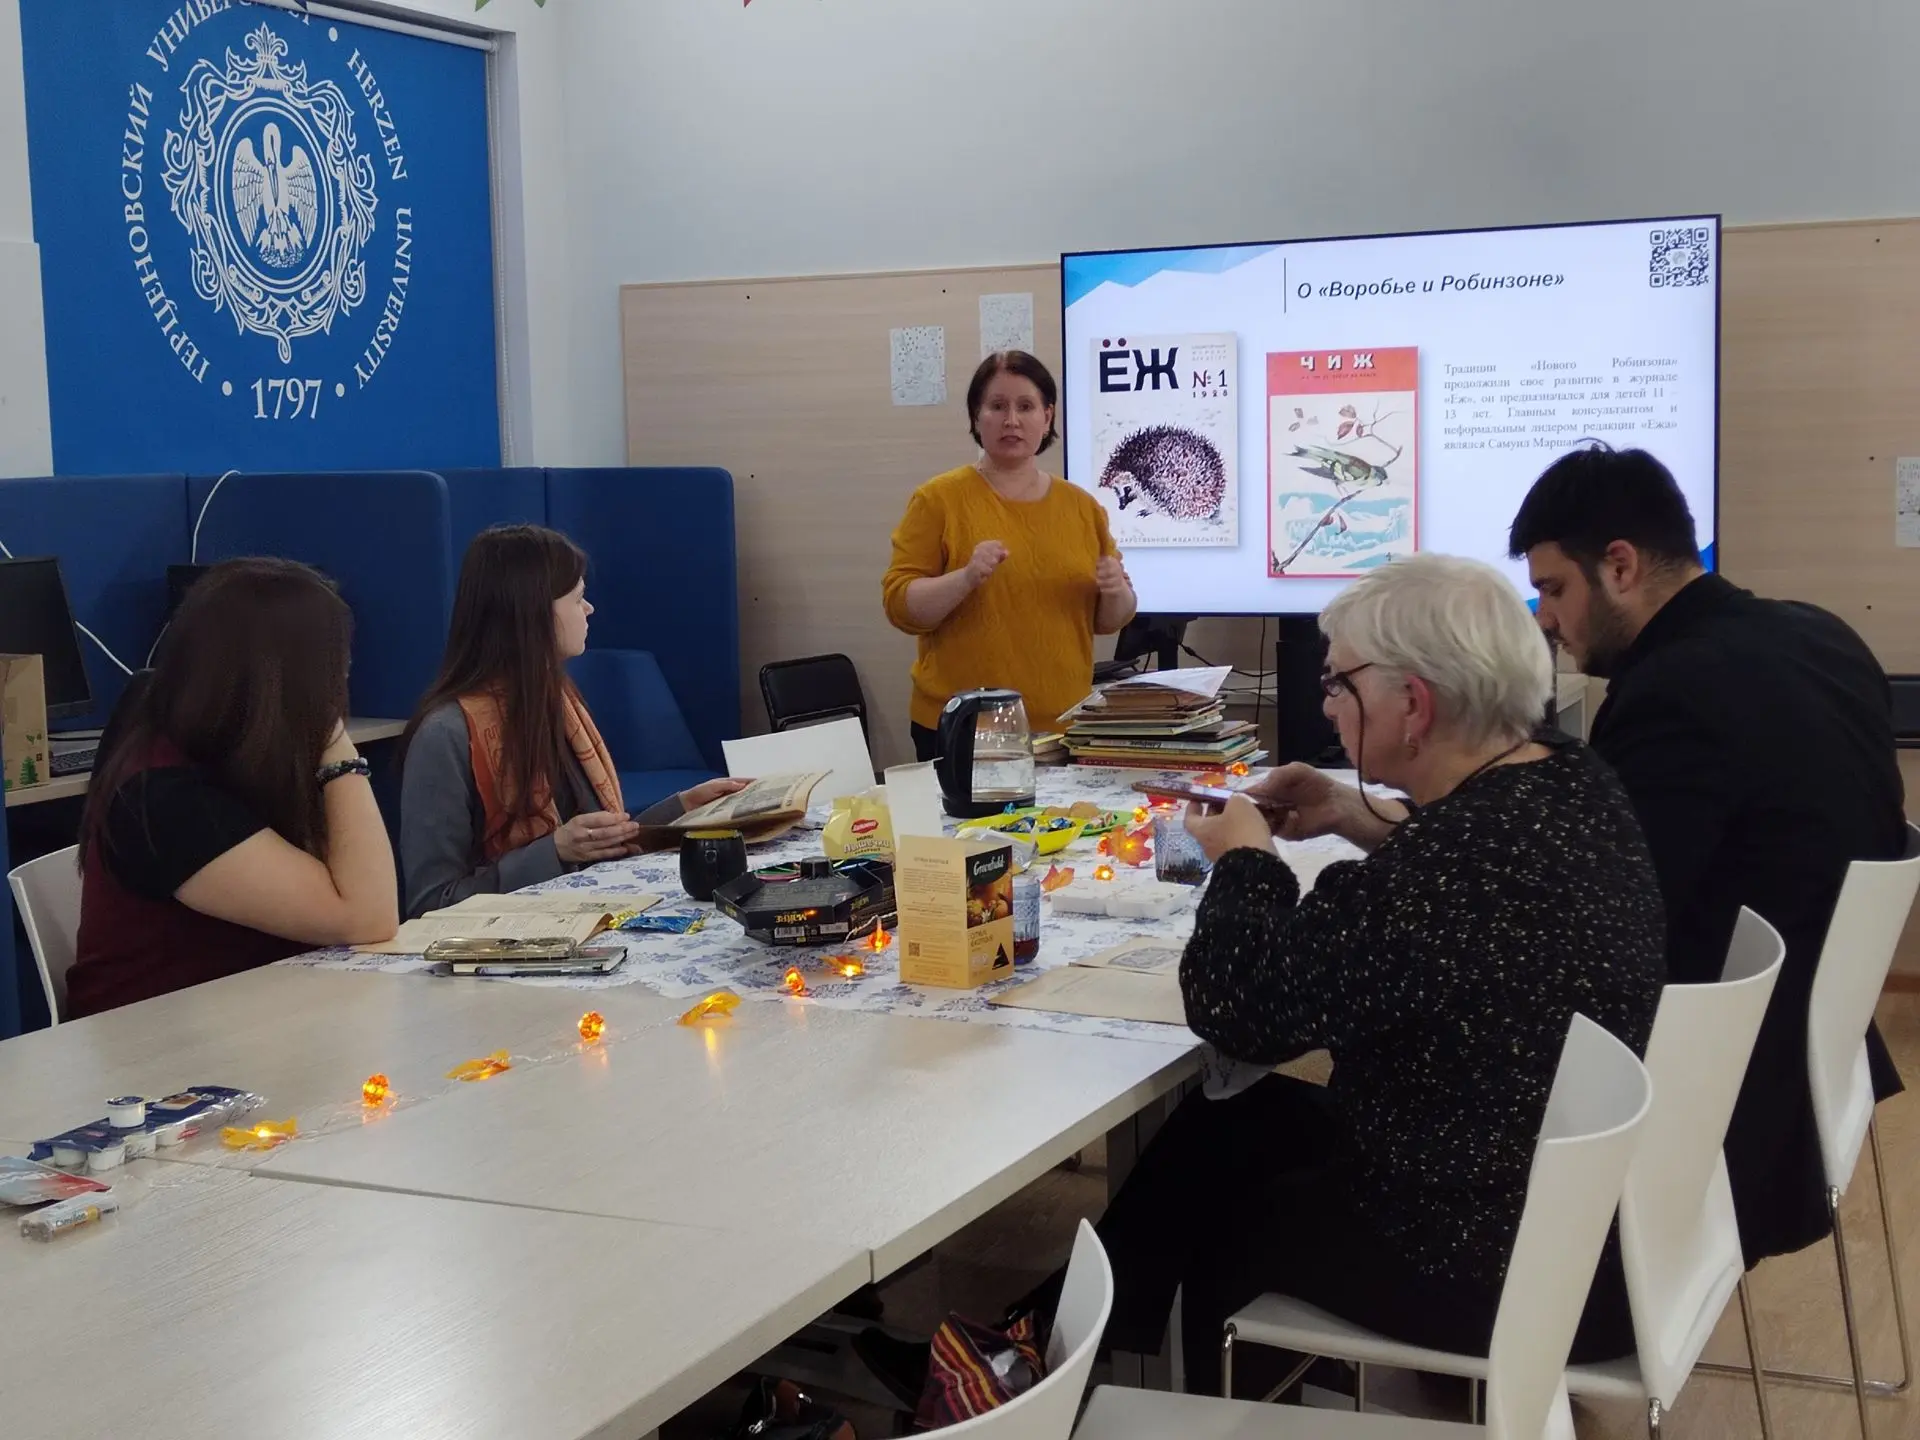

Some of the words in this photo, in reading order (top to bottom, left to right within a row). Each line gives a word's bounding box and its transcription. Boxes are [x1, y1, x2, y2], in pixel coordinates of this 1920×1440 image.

[347, 48, 408, 180] HERZEN
[122, 82, 212, 384] ГЕРЦЕНОВСКИЙ
[354, 207, 413, 389] UNIVERSITY
[1296, 282, 1312, 299] О
[1318, 277, 1416, 301] «Воробье
[1422, 279, 1434, 294] и
[1440, 272, 1566, 295] Робинзоне»
[1099, 337, 1180, 393] ЁЖ
[1444, 364, 1497, 376] Традиции
[1444, 379, 1511, 391] продолжили
[1554, 375, 1603, 388] развитие
[1629, 373, 1678, 385] журнале
[251, 378, 322, 420] 1797
[1481, 395, 1495, 403] он
[1500, 392, 1585, 405] предназначался
[1591, 391, 1610, 401] для
[1615, 388, 1647, 400] детей
[1445, 408, 1457, 419] 13
[1508, 407, 1556, 418] Главным
[1572, 405, 1654, 418] консультантом
[1670, 404, 1678, 413] и
[1444, 424, 1526, 437] неформальным
[1531, 423, 1578, 435] лидером
[1583, 421, 1635, 433] редакции
[1444, 440, 1485, 450] являлся
[1488, 438, 1530, 451] Самуил
